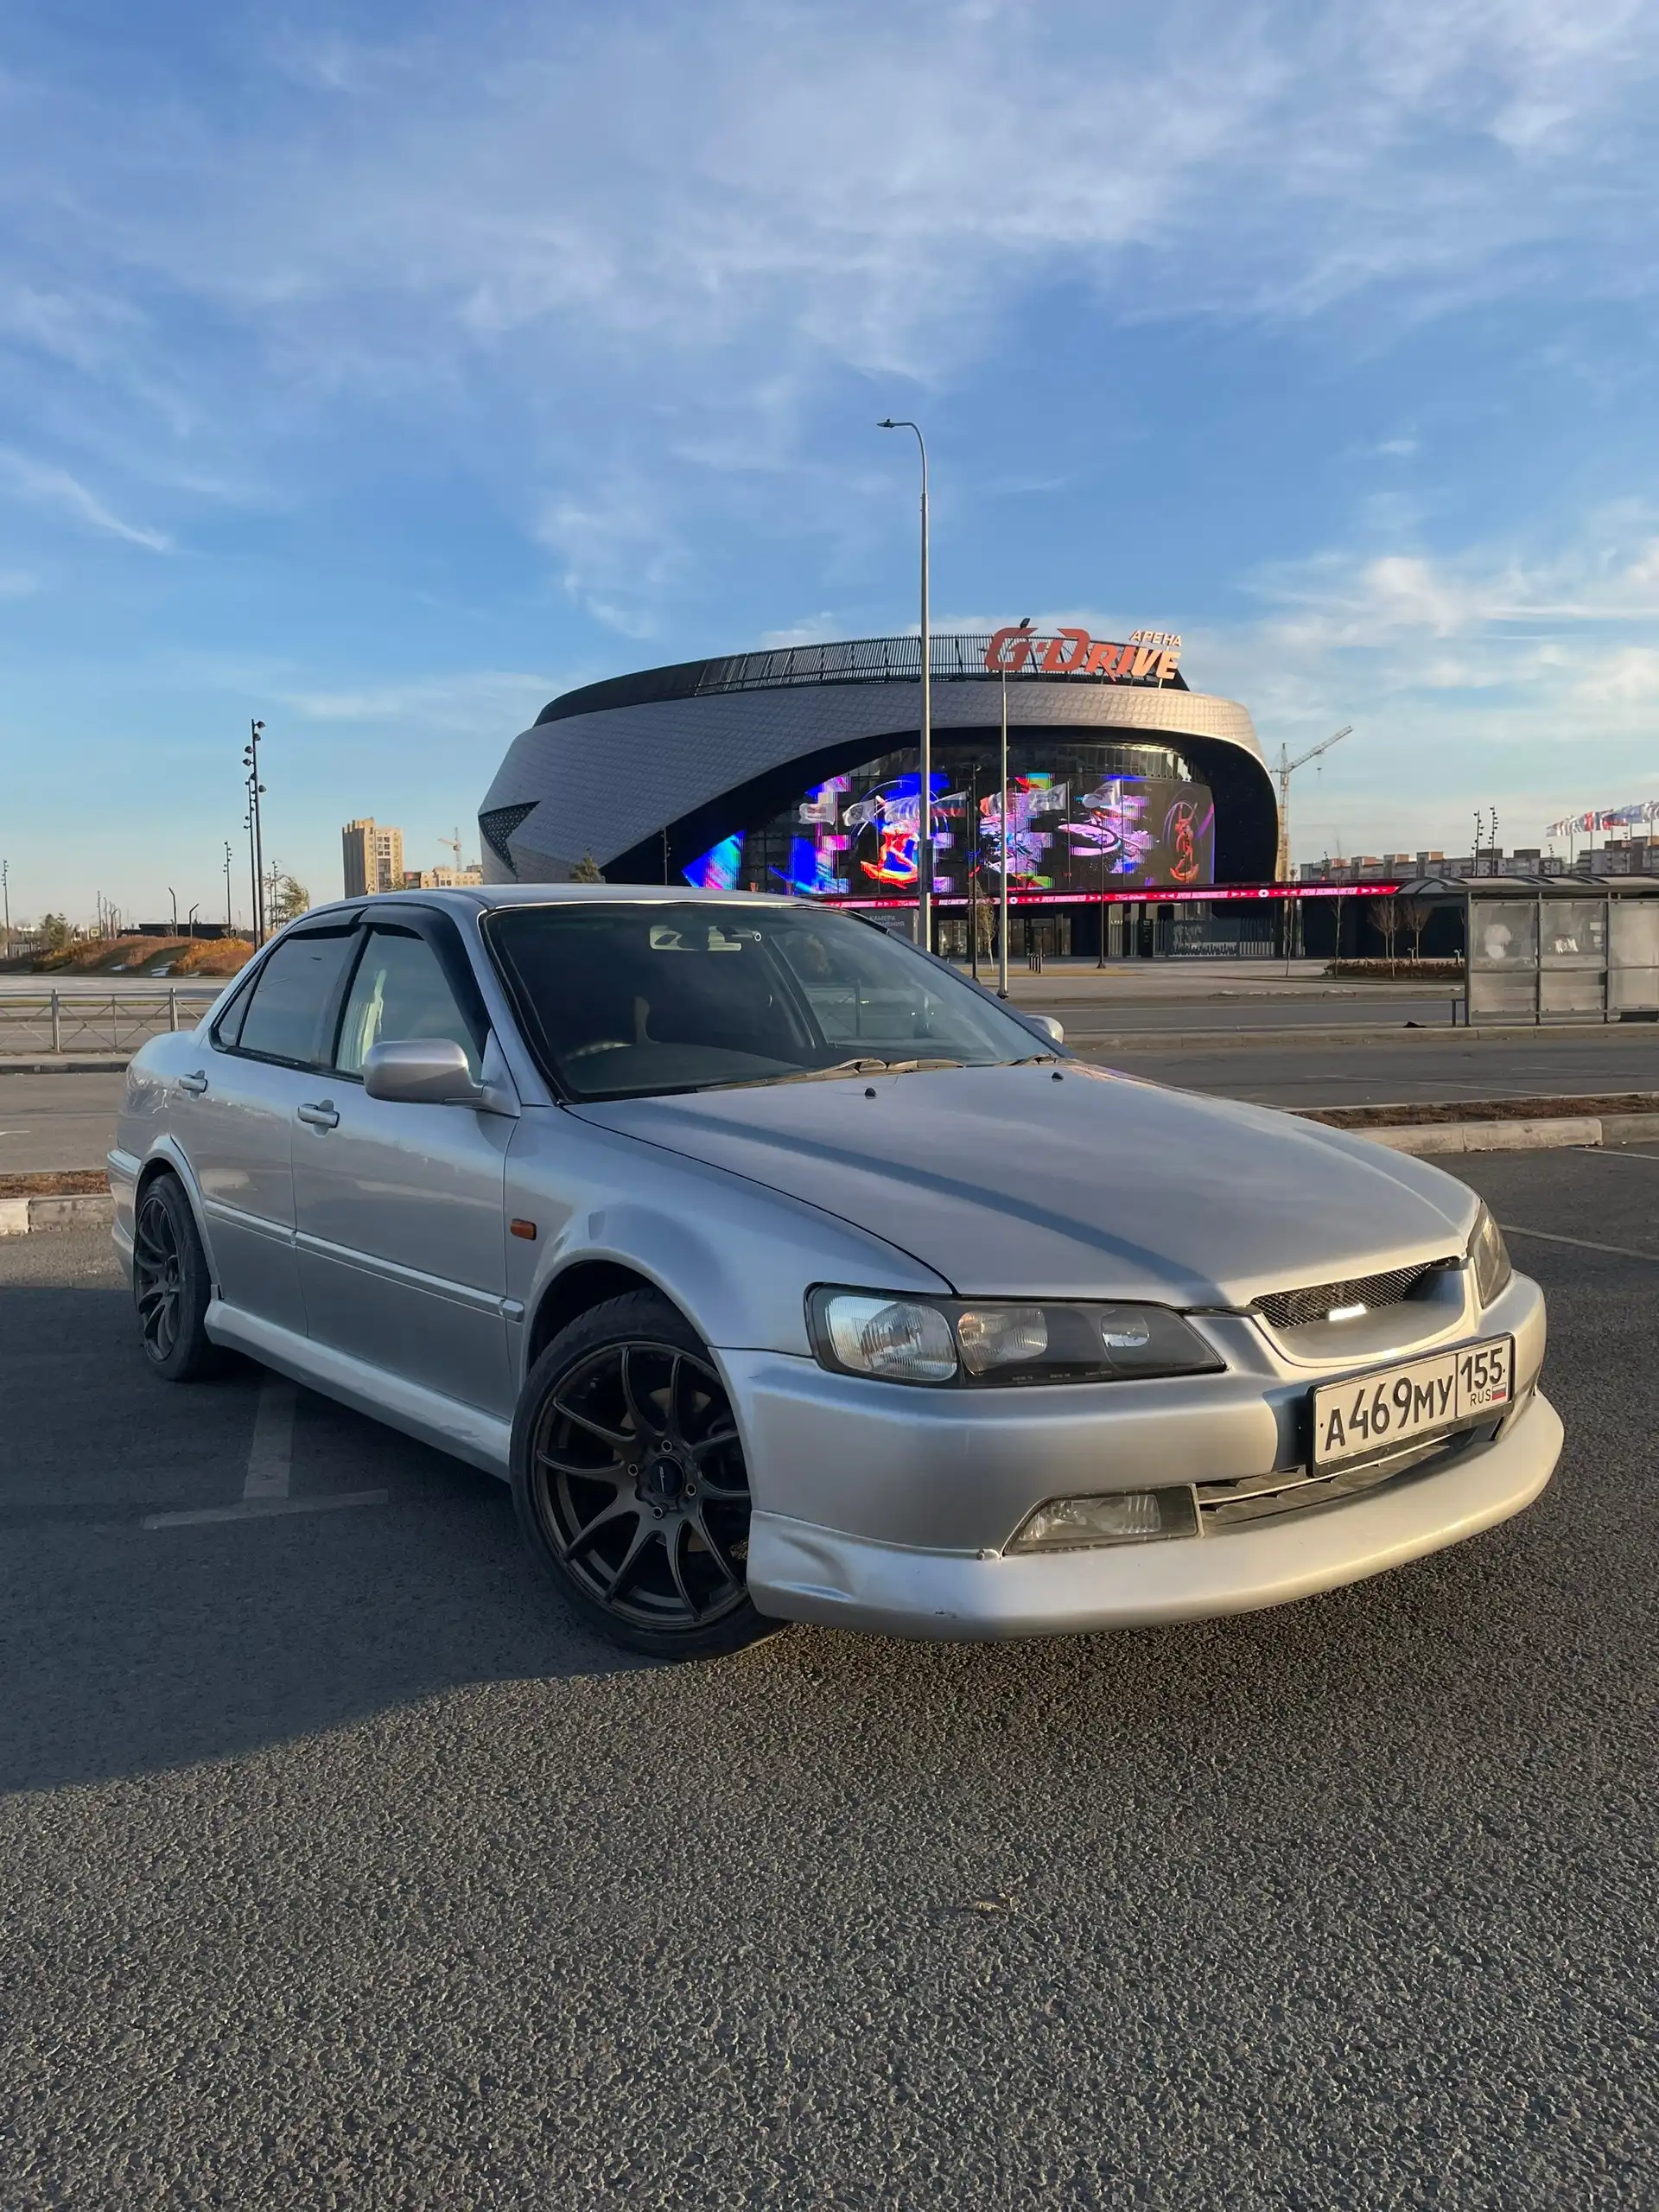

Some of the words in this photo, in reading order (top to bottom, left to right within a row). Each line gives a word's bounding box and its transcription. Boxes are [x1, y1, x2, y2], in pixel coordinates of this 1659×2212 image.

[1130, 629, 1182, 647] АРЕНА
[1325, 1375, 1454, 1452] А469МУ
[1460, 1347, 1503, 1393] 155
[1470, 1392, 1491, 1407] RUS
